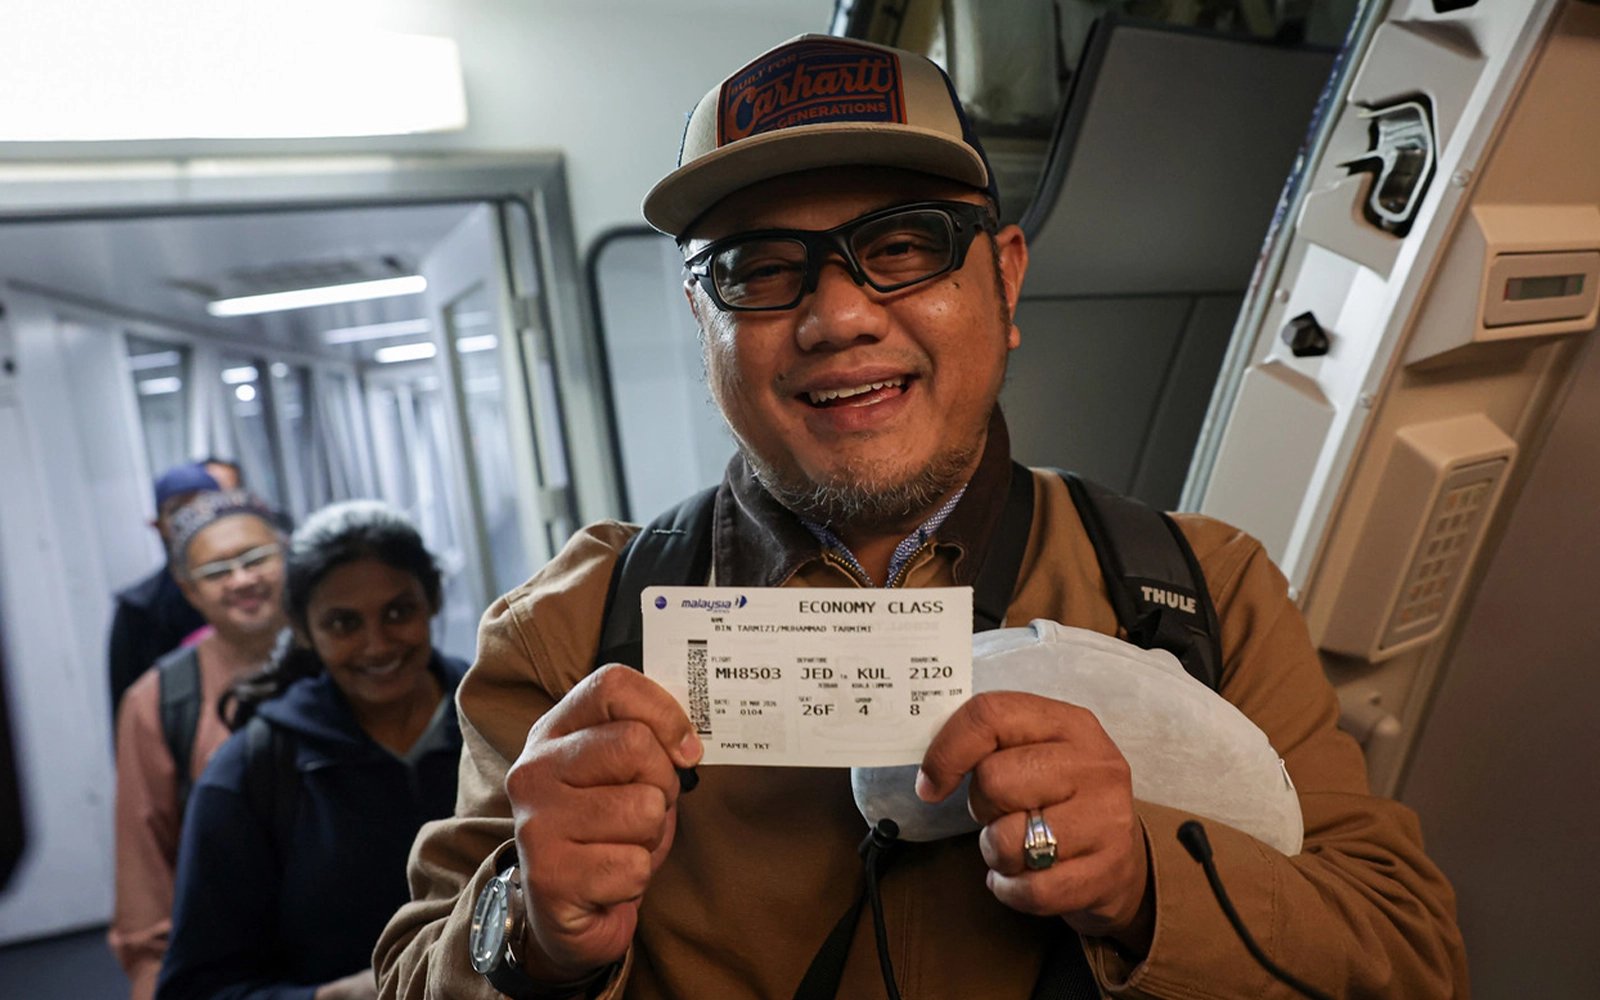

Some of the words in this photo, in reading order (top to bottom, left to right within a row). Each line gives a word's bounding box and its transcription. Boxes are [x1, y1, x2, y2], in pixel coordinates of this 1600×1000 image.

[731, 70, 764, 94] BUILT
[768, 53, 797, 73] FOR
[726, 58, 893, 140] Carhartt
[777, 102, 887, 129] GENERATIONS
[681, 599, 732, 610] malaysia
[1141, 586, 1196, 614] THULE
[799, 601, 876, 614] ECONOMY
[888, 601, 944, 614] CLASS
[715, 667, 782, 680] MH8503
[800, 667, 833, 680] JED
[857, 667, 890, 680] KUL
[909, 666, 953, 680] 2120
[802, 704, 835, 716] 26F
[859, 704, 869, 716] 4
[910, 704, 920, 716] 8
